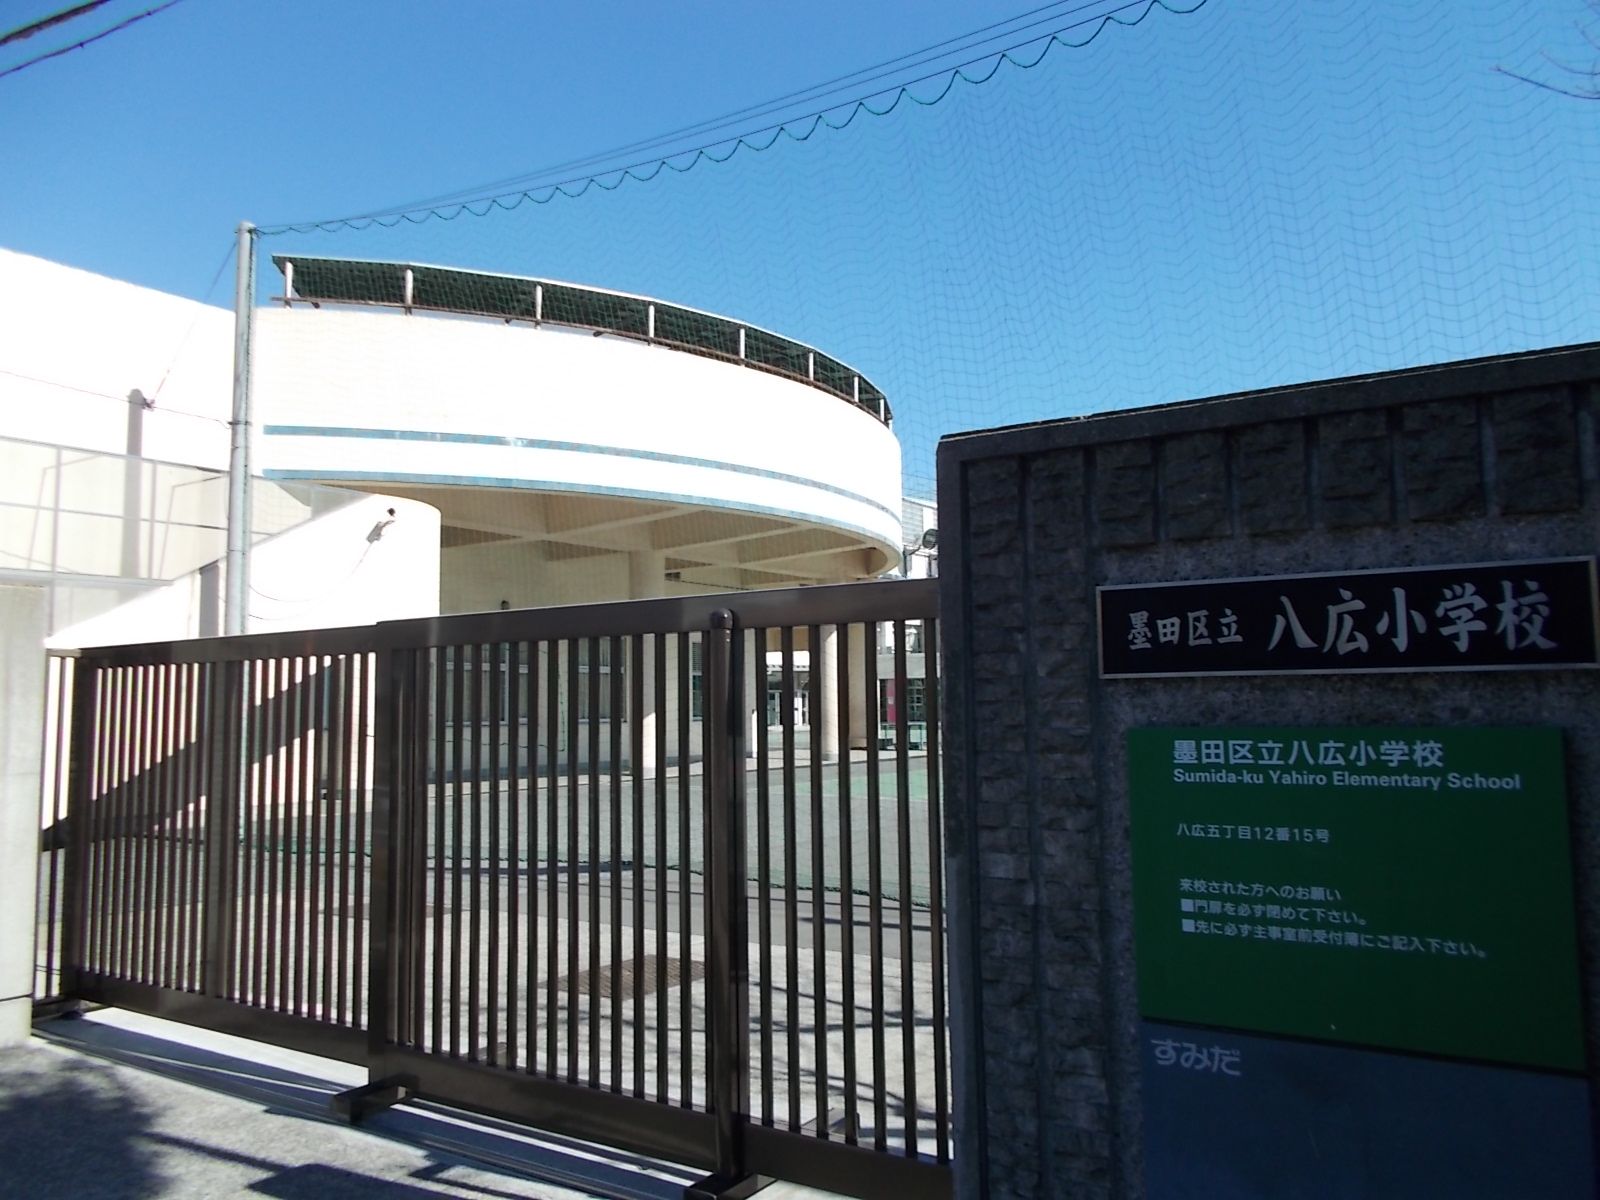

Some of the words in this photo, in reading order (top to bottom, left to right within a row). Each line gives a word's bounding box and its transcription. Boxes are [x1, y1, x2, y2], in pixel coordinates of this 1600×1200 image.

[1127, 608, 1244, 650] 墨田区立
[1267, 580, 1557, 655] 八広小学校
[1173, 740, 1444, 767] 墨田区立八広小学校
[1173, 768, 1264, 784] Sumida-ku
[1270, 770, 1327, 785] Yahiro
[1332, 771, 1441, 791] Elementary
[1447, 773, 1522, 790] School
[1176, 823, 1330, 843] 八広五丁目12番15号
[1151, 1038, 1242, 1077] すみだ
